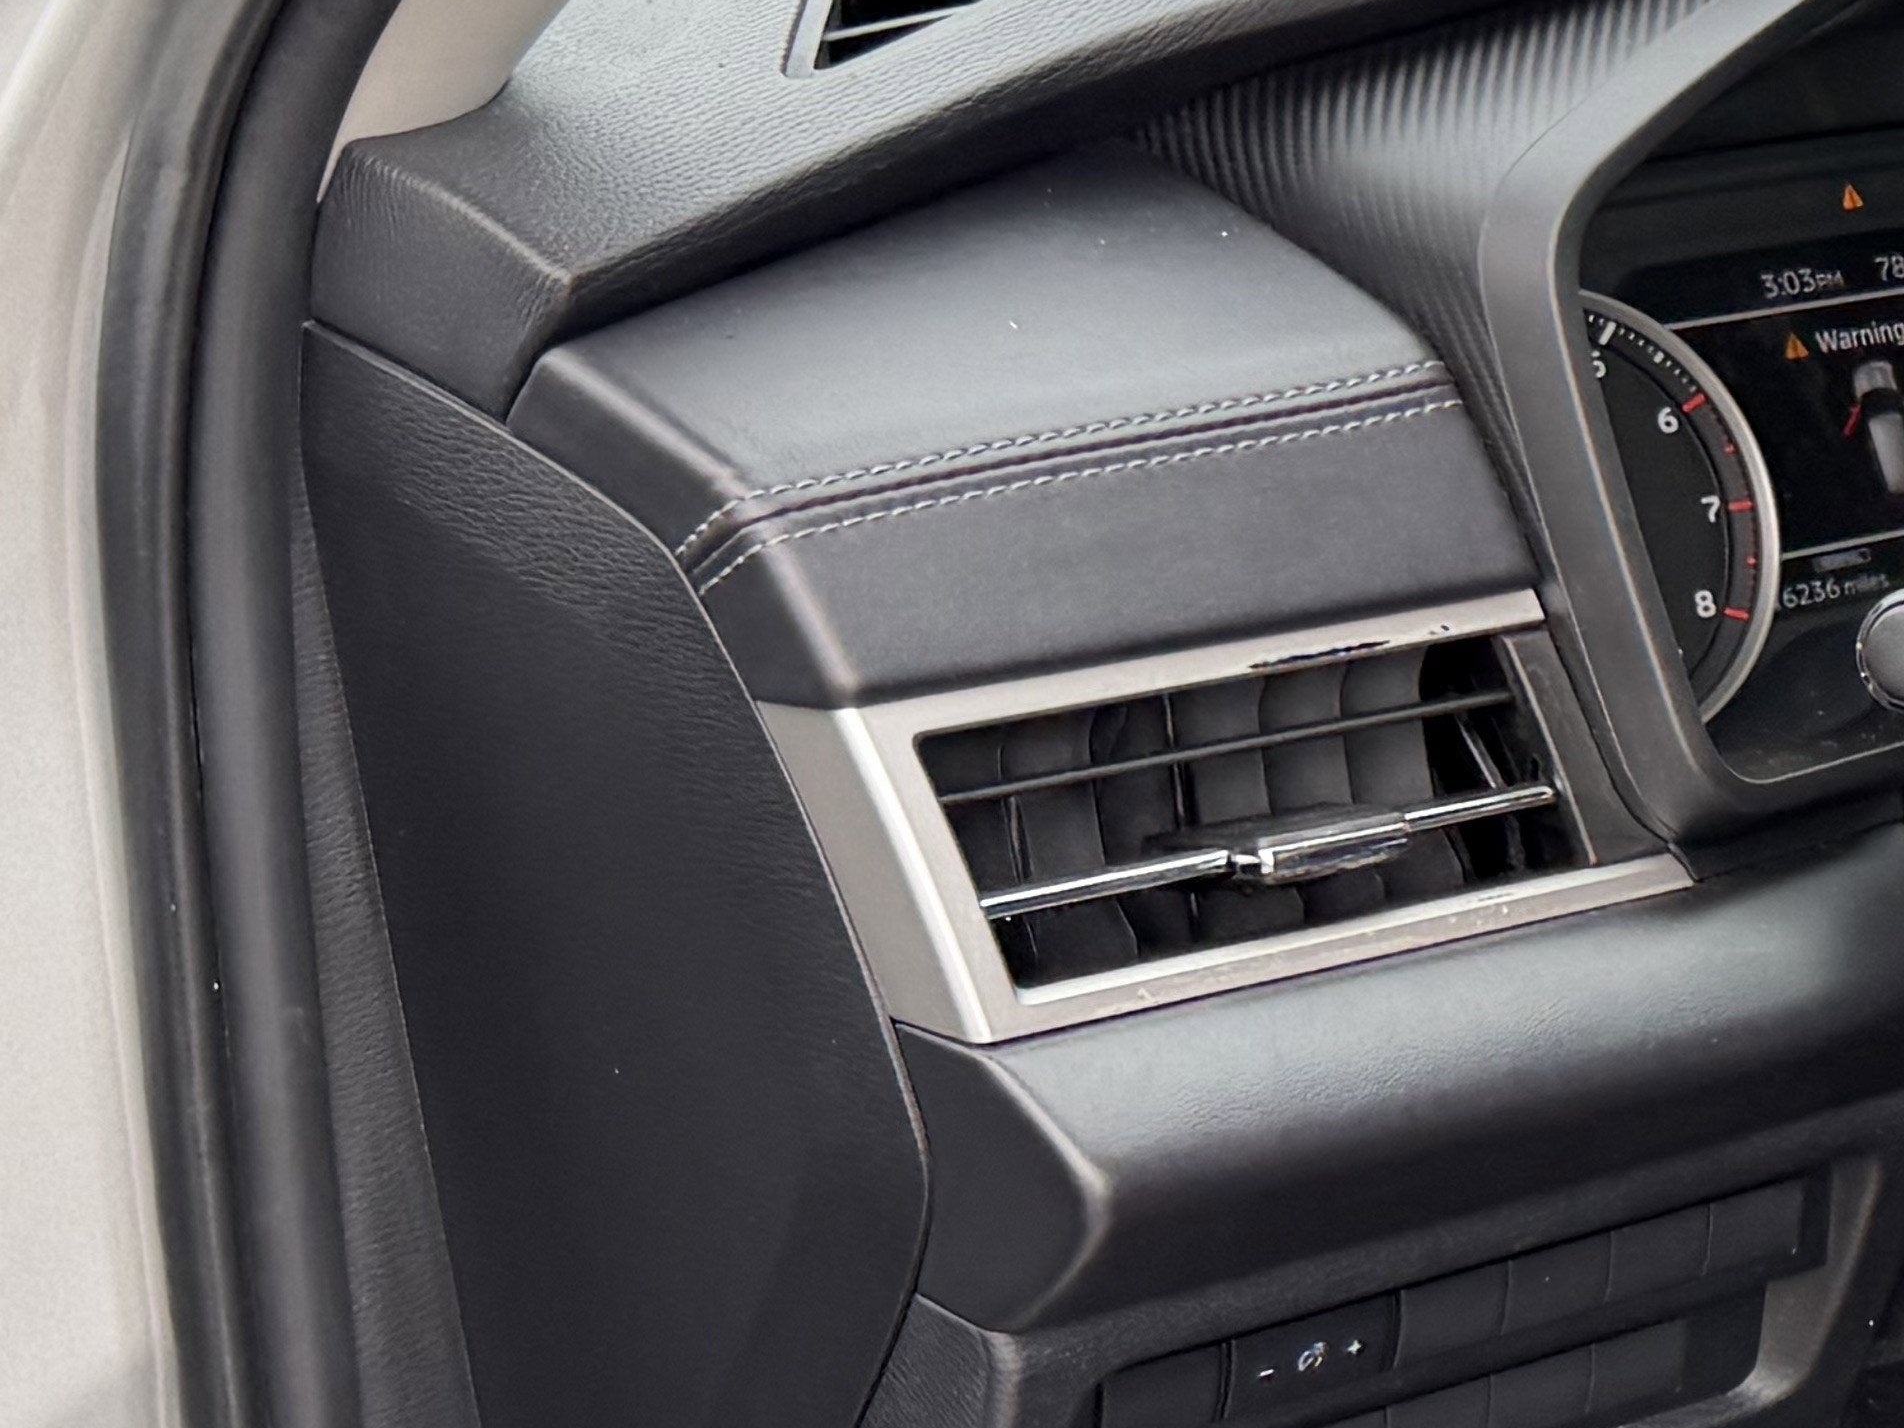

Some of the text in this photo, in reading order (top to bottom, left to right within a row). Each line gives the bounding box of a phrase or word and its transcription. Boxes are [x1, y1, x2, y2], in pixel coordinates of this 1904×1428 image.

[1657, 406, 1680, 434] 6
[1700, 495, 1721, 523] 7
[1693, 589, 1717, 618] 8
[1782, 577, 1841, 609] 6236
